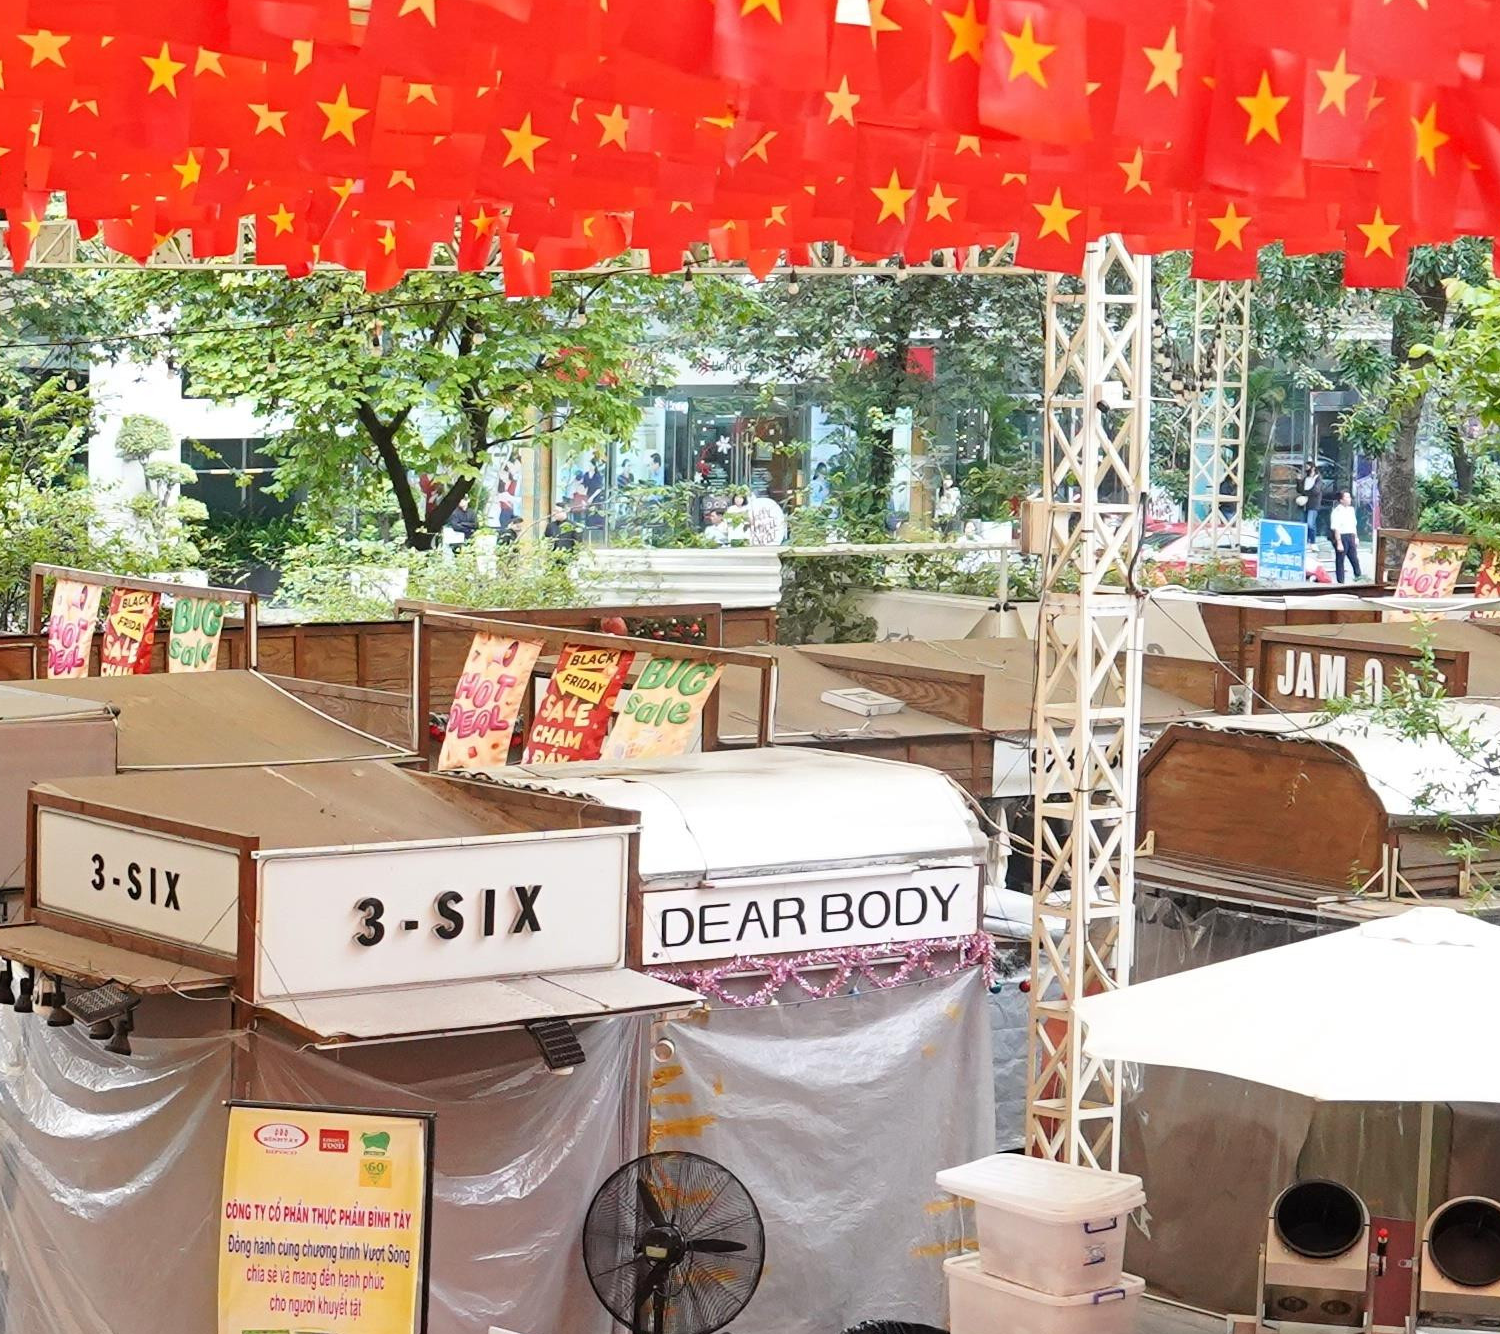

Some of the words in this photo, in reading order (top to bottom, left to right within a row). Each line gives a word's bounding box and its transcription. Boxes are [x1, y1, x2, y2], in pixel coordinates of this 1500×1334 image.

[1400, 566, 1449, 593] HOT
[122, 593, 150, 609] BLACK
[49, 615, 88, 648] HOT
[173, 598, 223, 637] BIG
[104, 635, 139, 664] SALE
[570, 651, 618, 668] BLACK
[456, 672, 517, 707] HOT
[563, 673, 607, 695] FRIDAY
[637, 657, 716, 697] BIG
[1277, 649, 1346, 700] JAM
[449, 704, 509, 739] DEAL
[542, 696, 594, 728] SALE
[90, 853, 184, 912] 3-SIX
[351, 883, 545, 947] 3-SIX
[660, 896, 807, 949] DEAR
[820, 882, 961, 935] BODY
[368, 1162, 385, 1174] 60
[225, 1198, 252, 1221] CÔNG
[254, 1204, 266, 1221] TY
[283, 1199, 309, 1224] PHẦN
[311, 1205, 337, 1230] THỰC
[338, 1201, 366, 1228] PHẨM
[367, 1205, 391, 1229] BÌNH
[393, 1208, 412, 1230] TÂY
[253, 1237, 276, 1255] hành
[277, 1237, 300, 1262] cùng
[302, 1238, 338, 1264] chương
[339, 1240, 361, 1260] trình
[363, 1242, 386, 1267] Vượt
[387, 1244, 411, 1269] Sóng
[246, 1264, 265, 1283] chia
[280, 1265, 290, 1284] và
[292, 1270, 317, 1291] mang
[319, 1266, 336, 1287] đến
[338, 1267, 361, 1293] hạnh
[362, 1270, 385, 1295] phúc
[269, 1293, 287, 1313] cho
[288, 1293, 316, 1318] người
[317, 1292, 348, 1320] khuyết
[349, 1296, 362, 1321] tật
